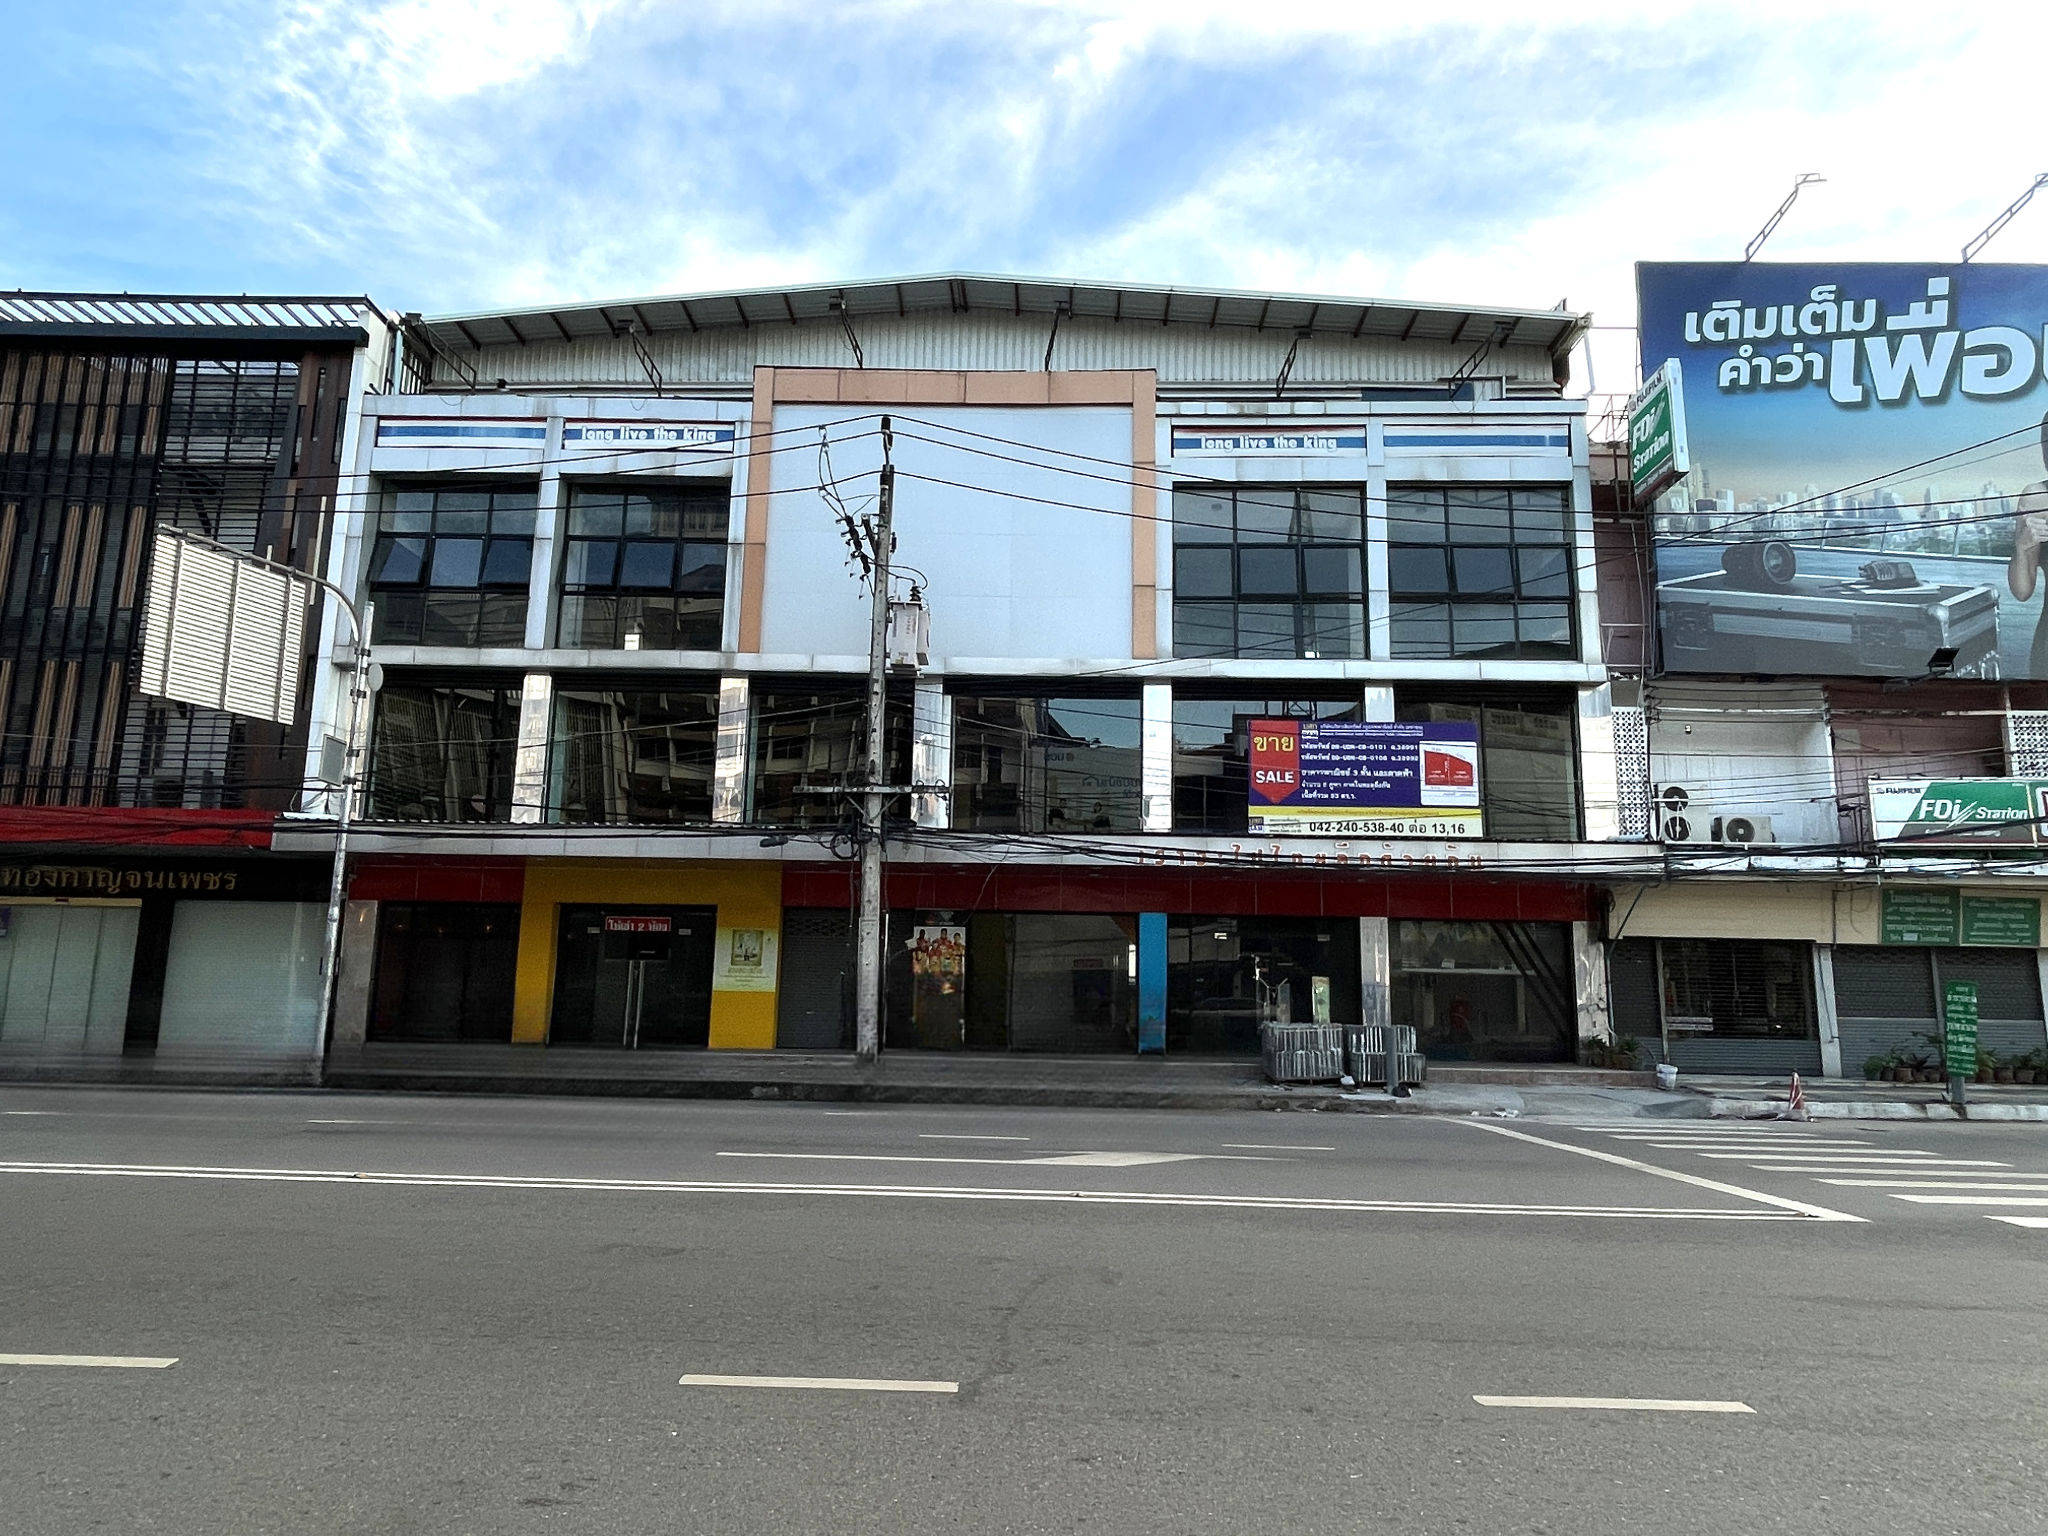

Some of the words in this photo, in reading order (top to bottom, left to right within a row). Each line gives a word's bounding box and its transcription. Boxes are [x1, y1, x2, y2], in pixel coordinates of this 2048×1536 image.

[1684, 284, 1877, 343] เติมเต็ม
[1718, 343, 1824, 388] คำว่า
[1828, 276, 2048, 404] เพื่อ
[619, 426, 648, 441] live
[653, 426, 678, 441] the
[683, 427, 717, 442] king
[1201, 435, 1234, 452] long
[1239, 435, 1268, 449] live
[1273, 434, 1298, 449] the
[1303, 434, 1338, 452] king
[1253, 736, 1295, 752] ขาย
[1255, 770, 1295, 784] SALE
[1976, 807, 2028, 820] Station
[1309, 821, 1404, 833] 042-240-538-40
[1408, 819, 1427, 834] ต่อ
[1432, 823, 1465, 836] 13,16
